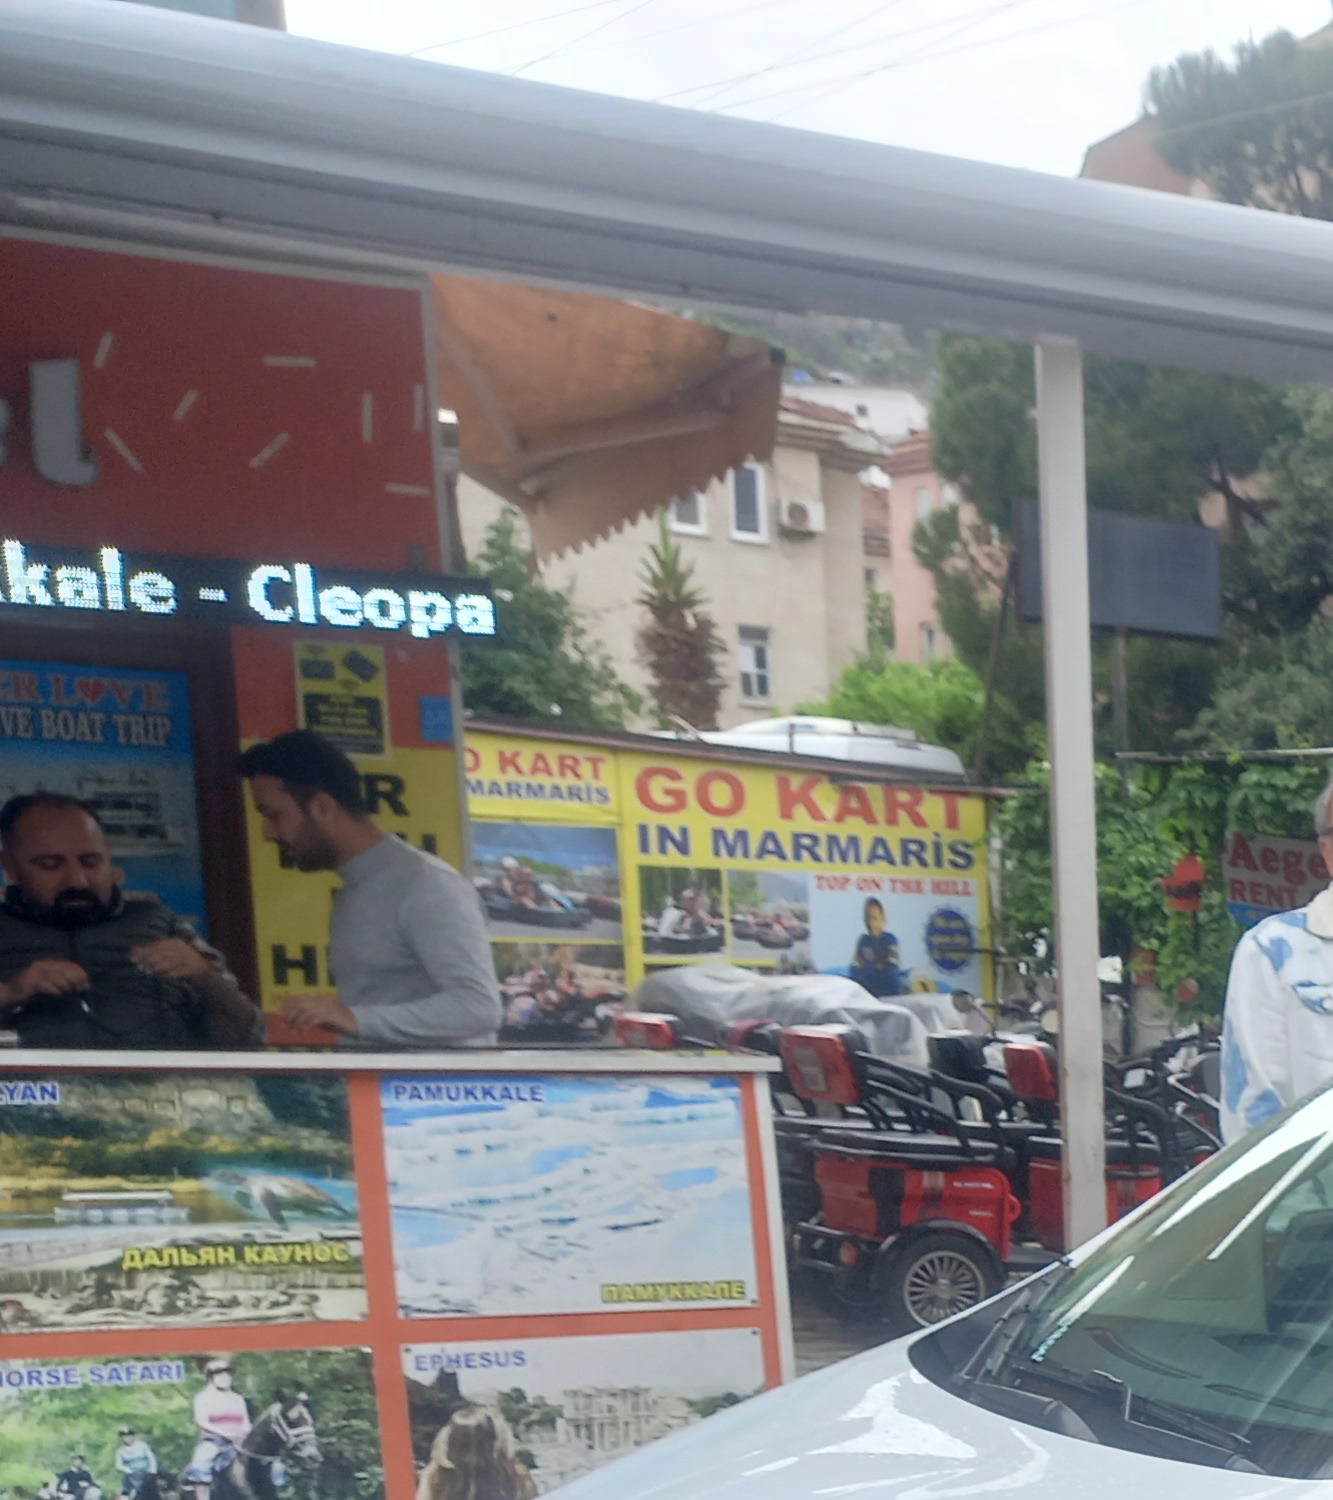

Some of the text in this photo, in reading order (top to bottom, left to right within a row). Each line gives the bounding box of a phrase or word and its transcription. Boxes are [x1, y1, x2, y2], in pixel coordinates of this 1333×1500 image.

[247, 561, 496, 638] Cleopa
[40, 708, 105, 743] BOAT
[112, 713, 171, 746] TRIP
[497, 749, 606, 781] KART
[635, 765, 970, 830] GO KART
[637, 823, 691, 858] IN
[815, 874, 972, 896] TOP ON THE HILL
[1229, 878, 1297, 908] RENT
[0, 1083, 58, 1103] YAN
[393, 1084, 544, 1102] PAMUKKALE
[122, 1243, 350, 1271] ДАЛЬЯН КАУНОС
[602, 1280, 745, 1302] ПАМУККАЛЕ
[89, 1363, 183, 1384] SAFARI
[415, 1350, 526, 1372] EPHESUS
